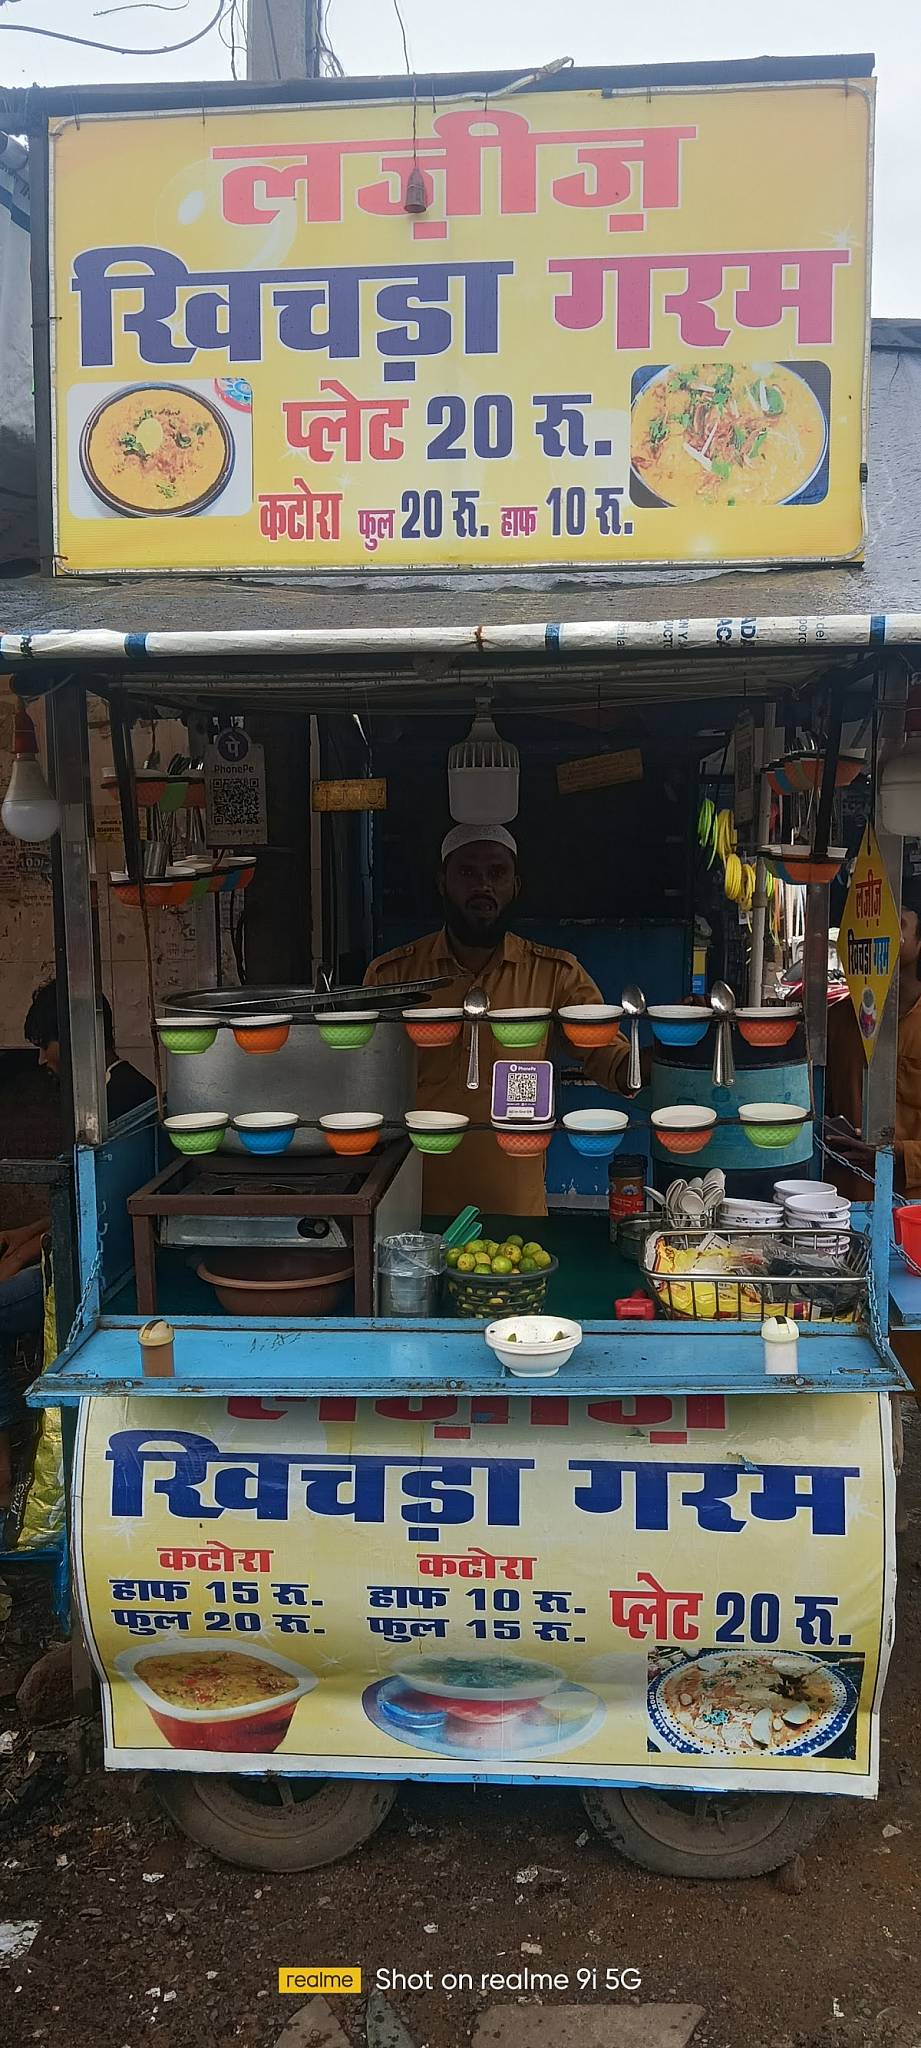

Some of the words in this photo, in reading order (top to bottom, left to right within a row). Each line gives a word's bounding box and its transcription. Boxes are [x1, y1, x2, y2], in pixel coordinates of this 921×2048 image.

[211, 109, 697, 239] लज़ीज़
[72, 246, 514, 381] खिचड़ा
[549, 250, 850, 348] गरम
[283, 379, 409, 462] प्लेट
[427, 395, 512, 459] 20
[258, 478, 343, 541] कटोरा
[358, 510, 395, 550] फुल
[401, 490, 442, 538] 20
[501, 507, 537, 536] हाफ
[546, 487, 585, 535] 10
[214, 763, 255, 774] PhonePe
[106, 1430, 534, 1541] खिचड़ा
[568, 1460, 859, 1536] गरम
[157, 1541, 274, 1572] कटोरा
[417, 1547, 537, 1579] कटोरा
[109, 1579, 190, 1602] हाफ
[205, 1581, 259, 1604] 15
[367, 1586, 450, 1609] हाफ
[466, 1589, 519, 1611] 10
[610, 1572, 704, 1640] प्लेट
[716, 1592, 780, 1643] 20
[111, 1609, 191, 1635] फुल
[204, 1612, 261, 1631] 20
[367, 1617, 450, 1642] फुल
[466, 1619, 520, 1639] 15
